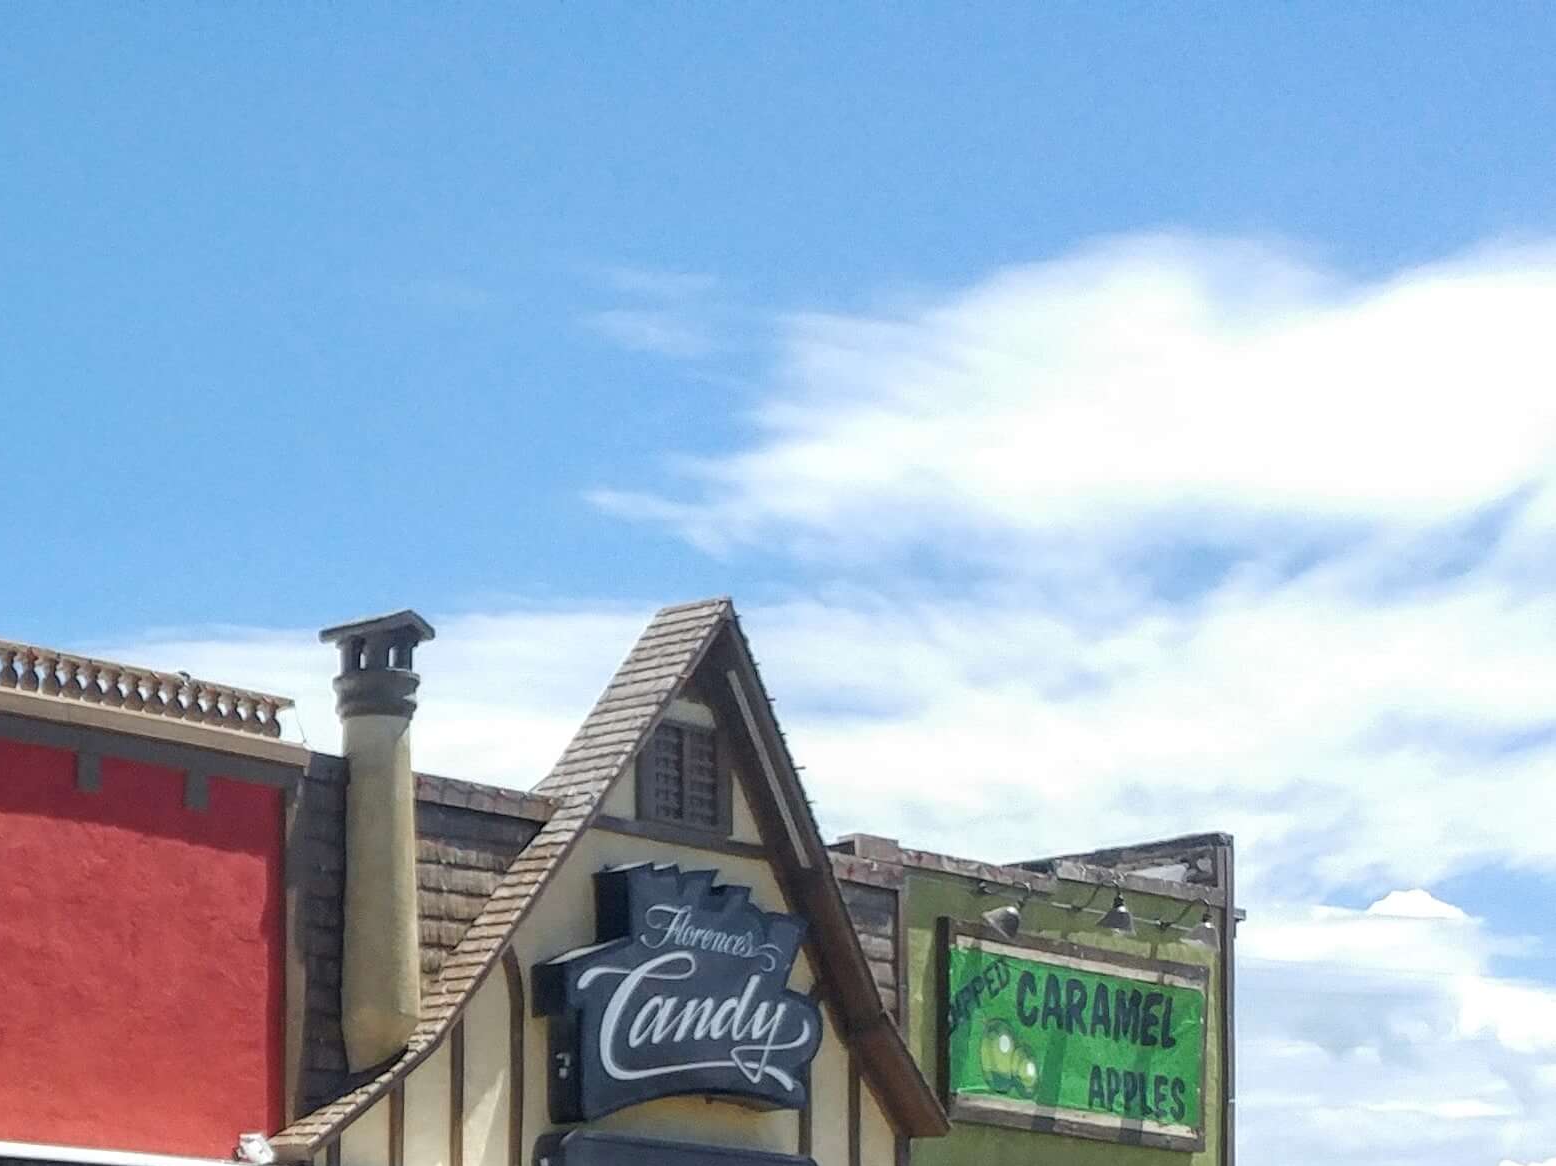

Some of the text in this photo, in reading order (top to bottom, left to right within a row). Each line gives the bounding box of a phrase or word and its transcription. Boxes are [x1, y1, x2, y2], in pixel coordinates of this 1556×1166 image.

[577, 951, 812, 1091] Candy
[1015, 970, 1177, 1049] CARAMEL
[1088, 1064, 1186, 1121] APPLES
